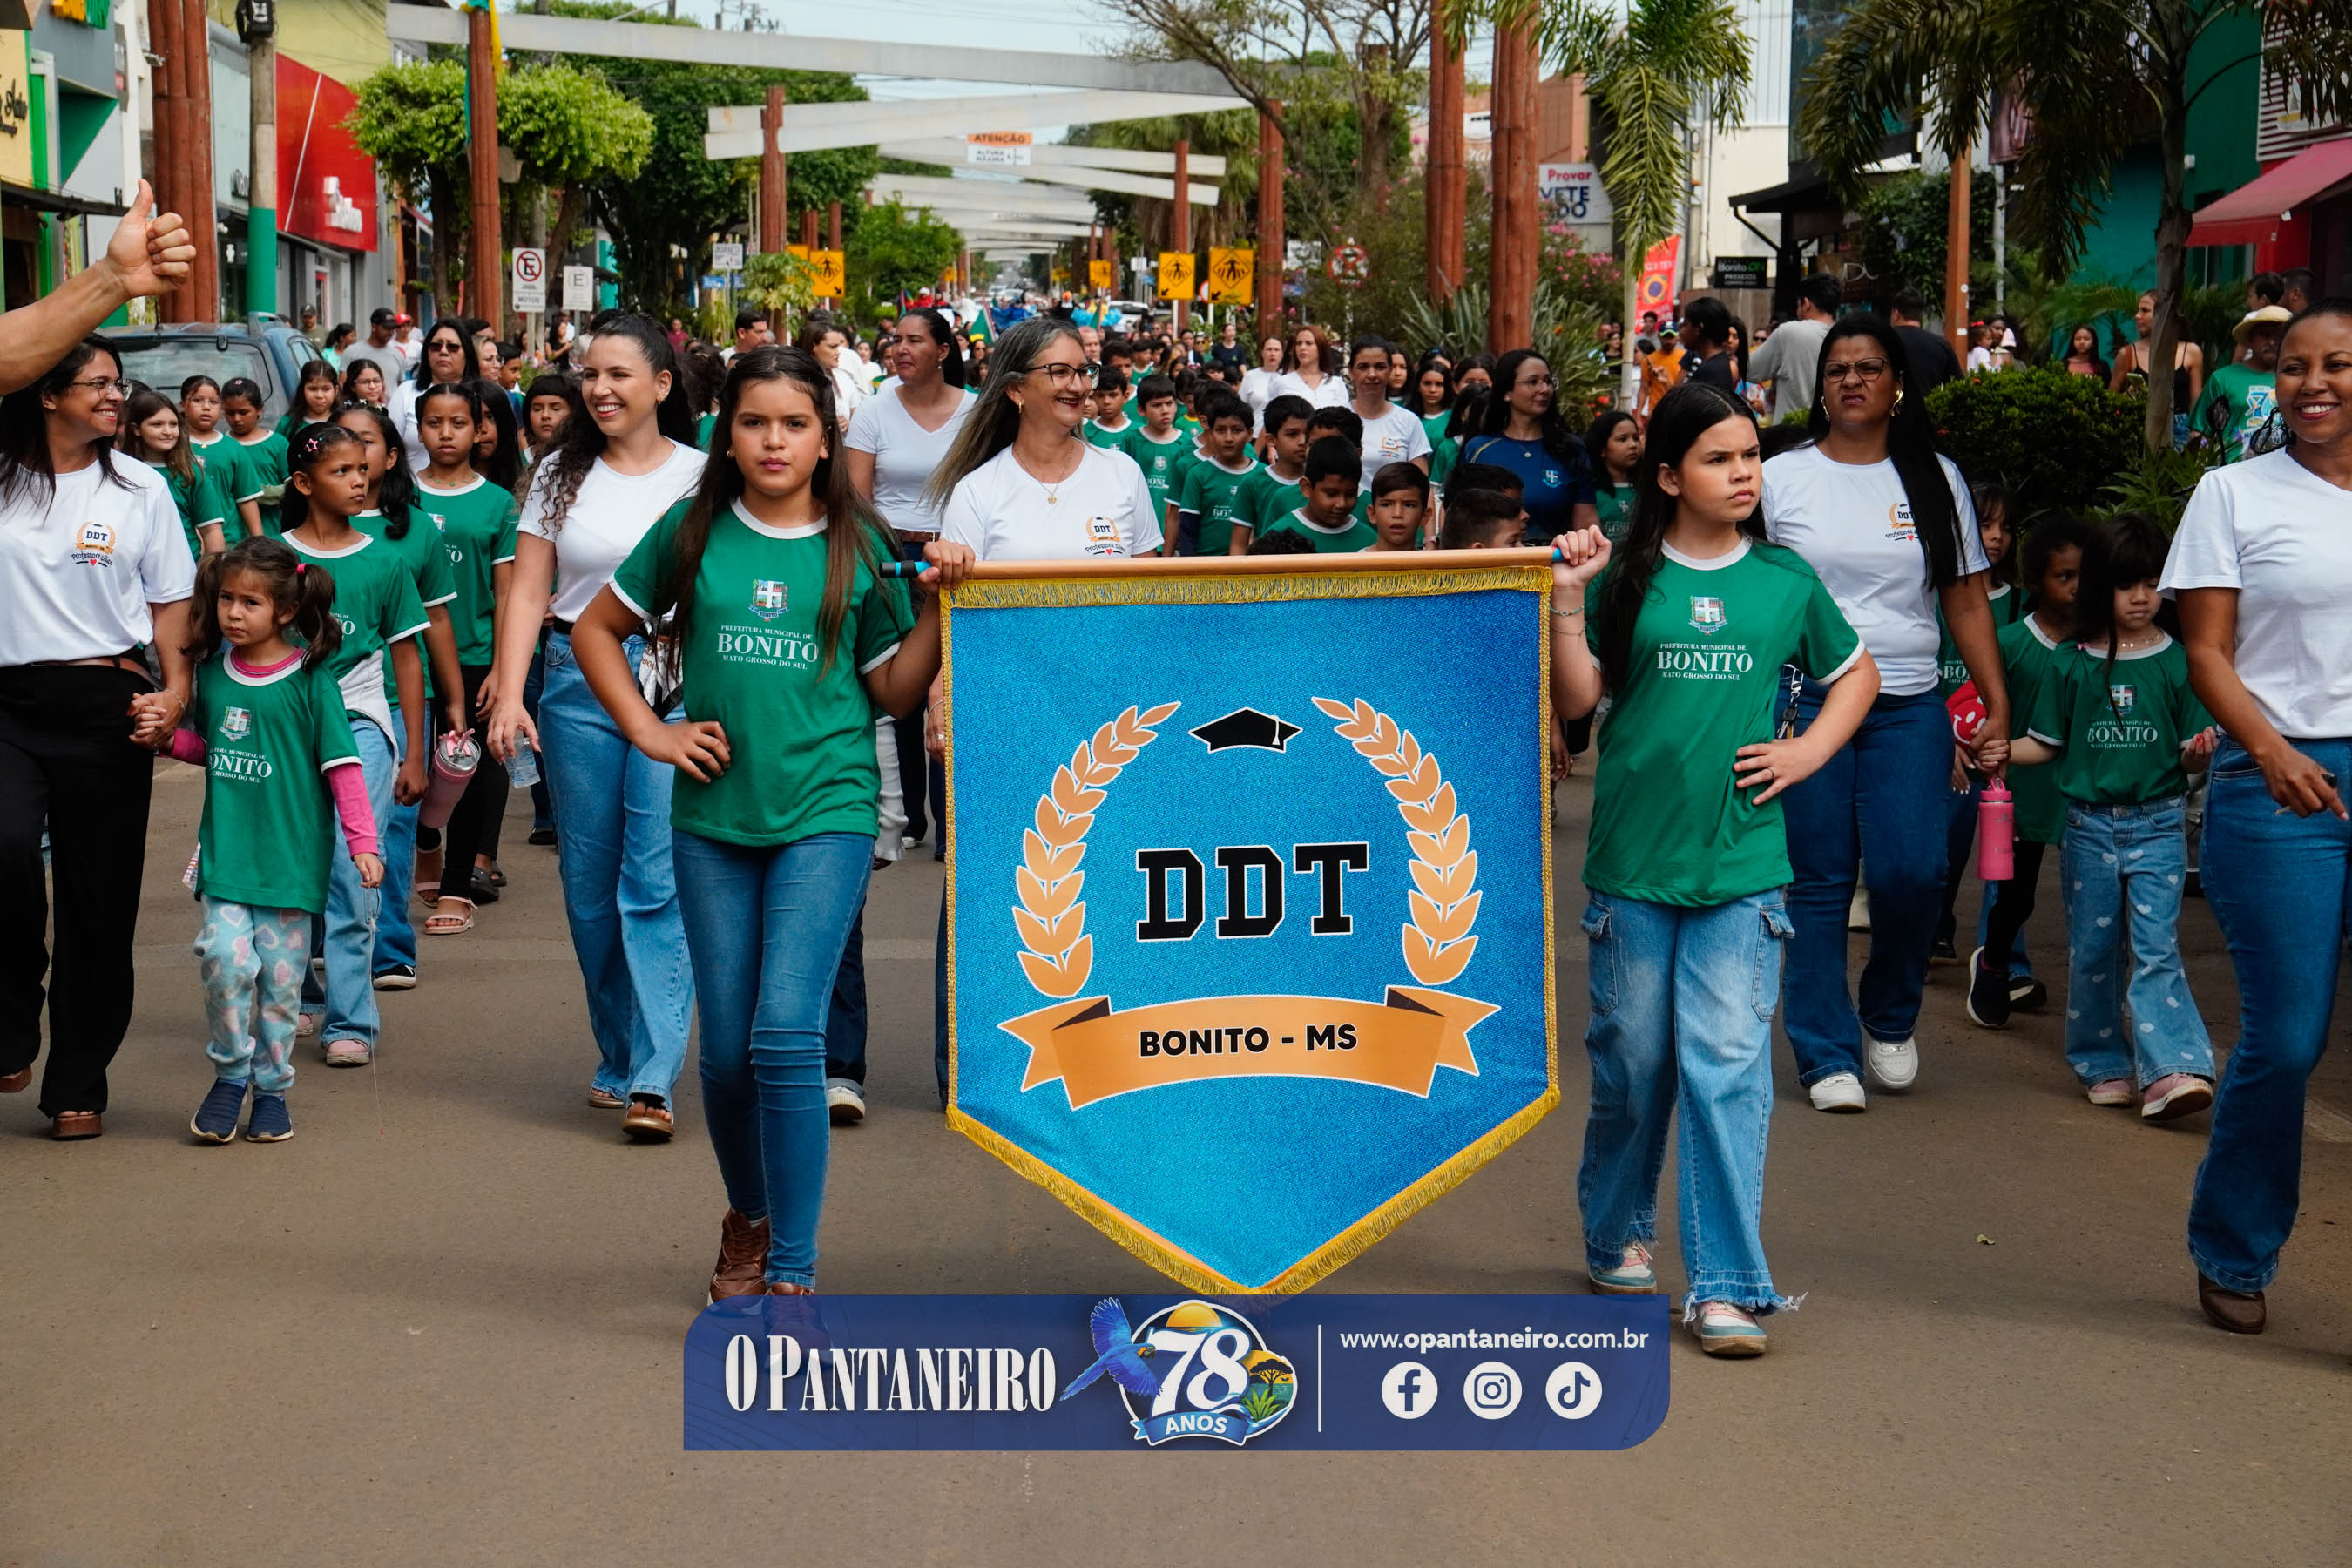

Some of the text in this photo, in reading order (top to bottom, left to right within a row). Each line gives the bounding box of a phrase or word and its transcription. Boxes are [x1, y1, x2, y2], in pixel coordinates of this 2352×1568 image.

[974, 132, 1025, 144] ATENÇÃO
[1548, 169, 1592, 181] Provar
[574, 274, 584, 287] E
[85, 531, 108, 541] DDT
[721, 625, 762, 634] PREFEITURA
[765, 628, 801, 639] MUNICIPAL
[717, 633, 820, 663] BONITO
[745, 656, 777, 666] GROSSO
[1657, 650, 1754, 673] BONITO
[2087, 727, 2159, 742] BONITO
[228, 749, 258, 759] MUNICIPAL
[209, 754, 273, 778] ONITO
[212, 770, 237, 780] GROSSO
[1136, 841, 1369, 941] DDT
[1139, 1026, 1271, 1058] BONITO
[1306, 1024, 1358, 1051] MS
